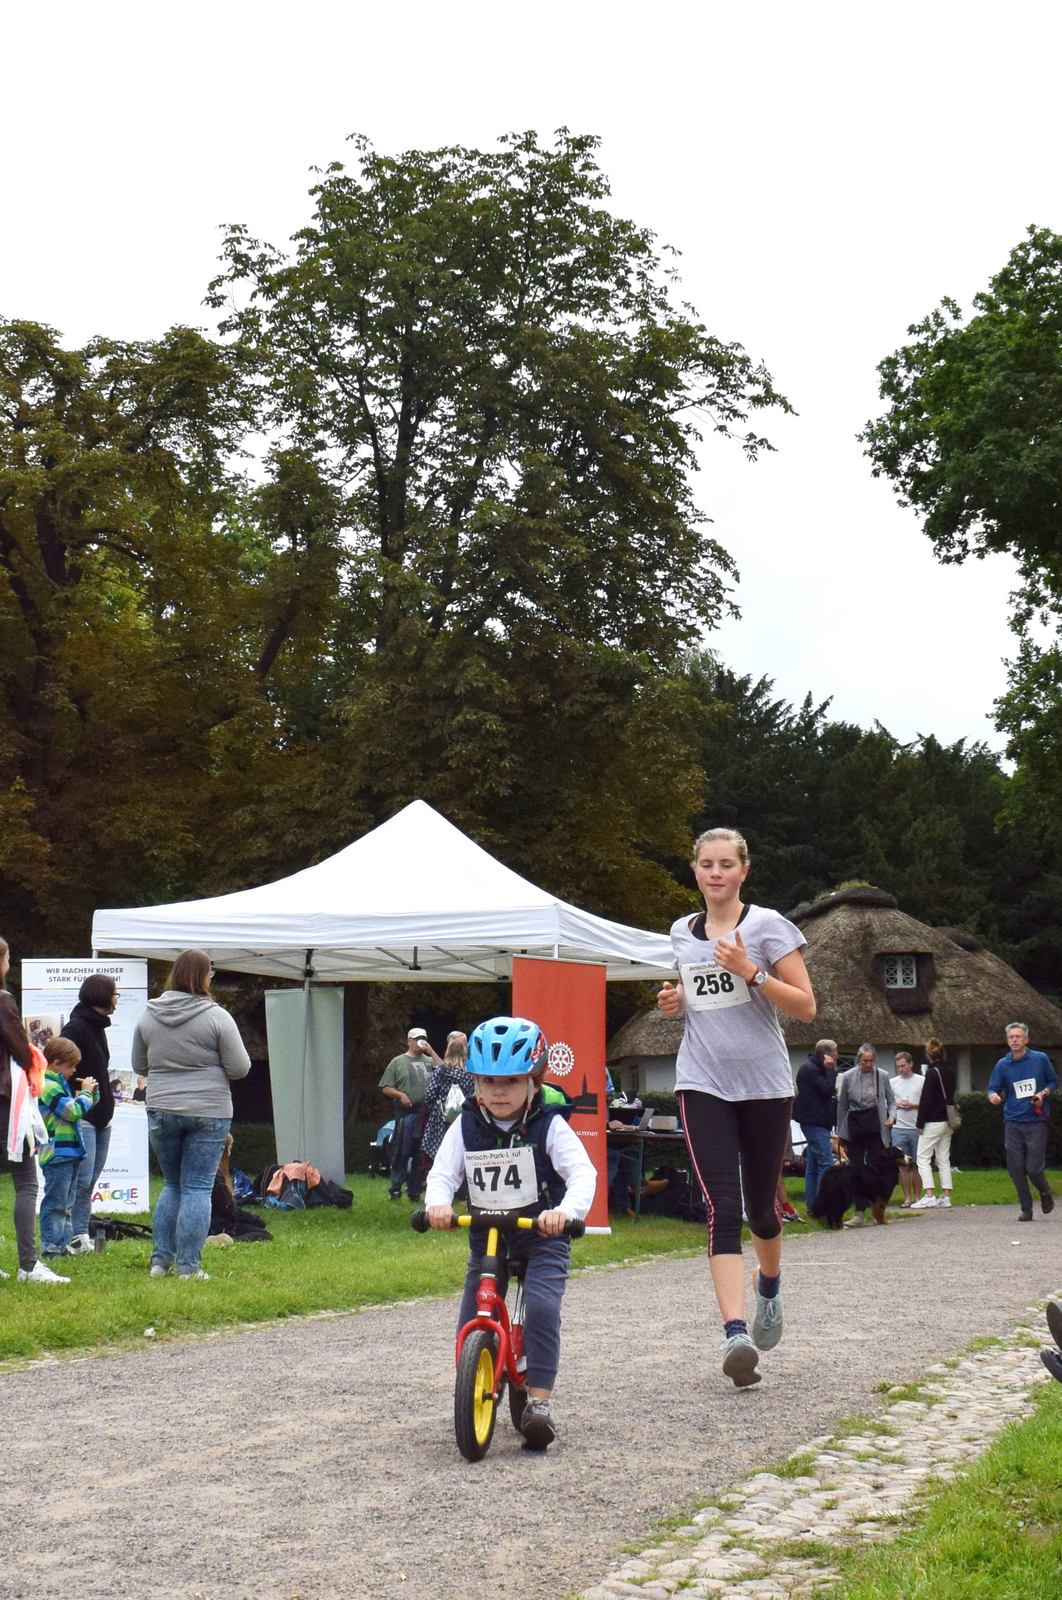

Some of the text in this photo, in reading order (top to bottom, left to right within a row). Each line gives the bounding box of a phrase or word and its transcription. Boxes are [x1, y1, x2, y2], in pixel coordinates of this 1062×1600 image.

[693, 972, 734, 996] 258
[1019, 1083, 1032, 1092] 173
[473, 1164, 523, 1192] 474
[91, 1187, 139, 1203] ARCHE
